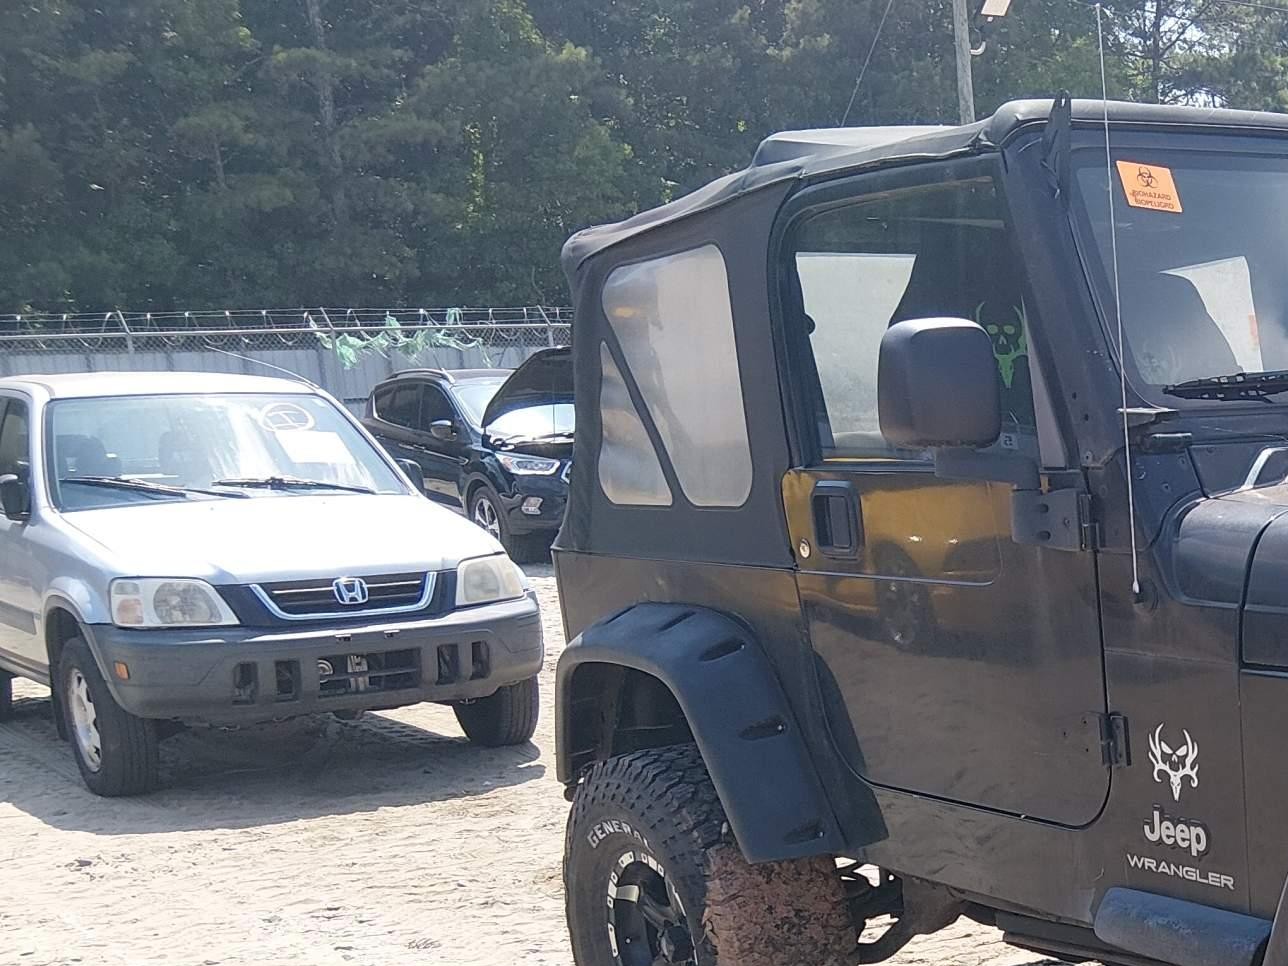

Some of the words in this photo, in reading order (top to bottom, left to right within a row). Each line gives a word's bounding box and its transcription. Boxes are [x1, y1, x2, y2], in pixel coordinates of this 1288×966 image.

[1131, 190, 1172, 200] BIOHAZARD
[587, 819, 655, 854] GENERAL
[1144, 810, 1206, 857] Jeep
[1127, 853, 1235, 890] WRANGLER
